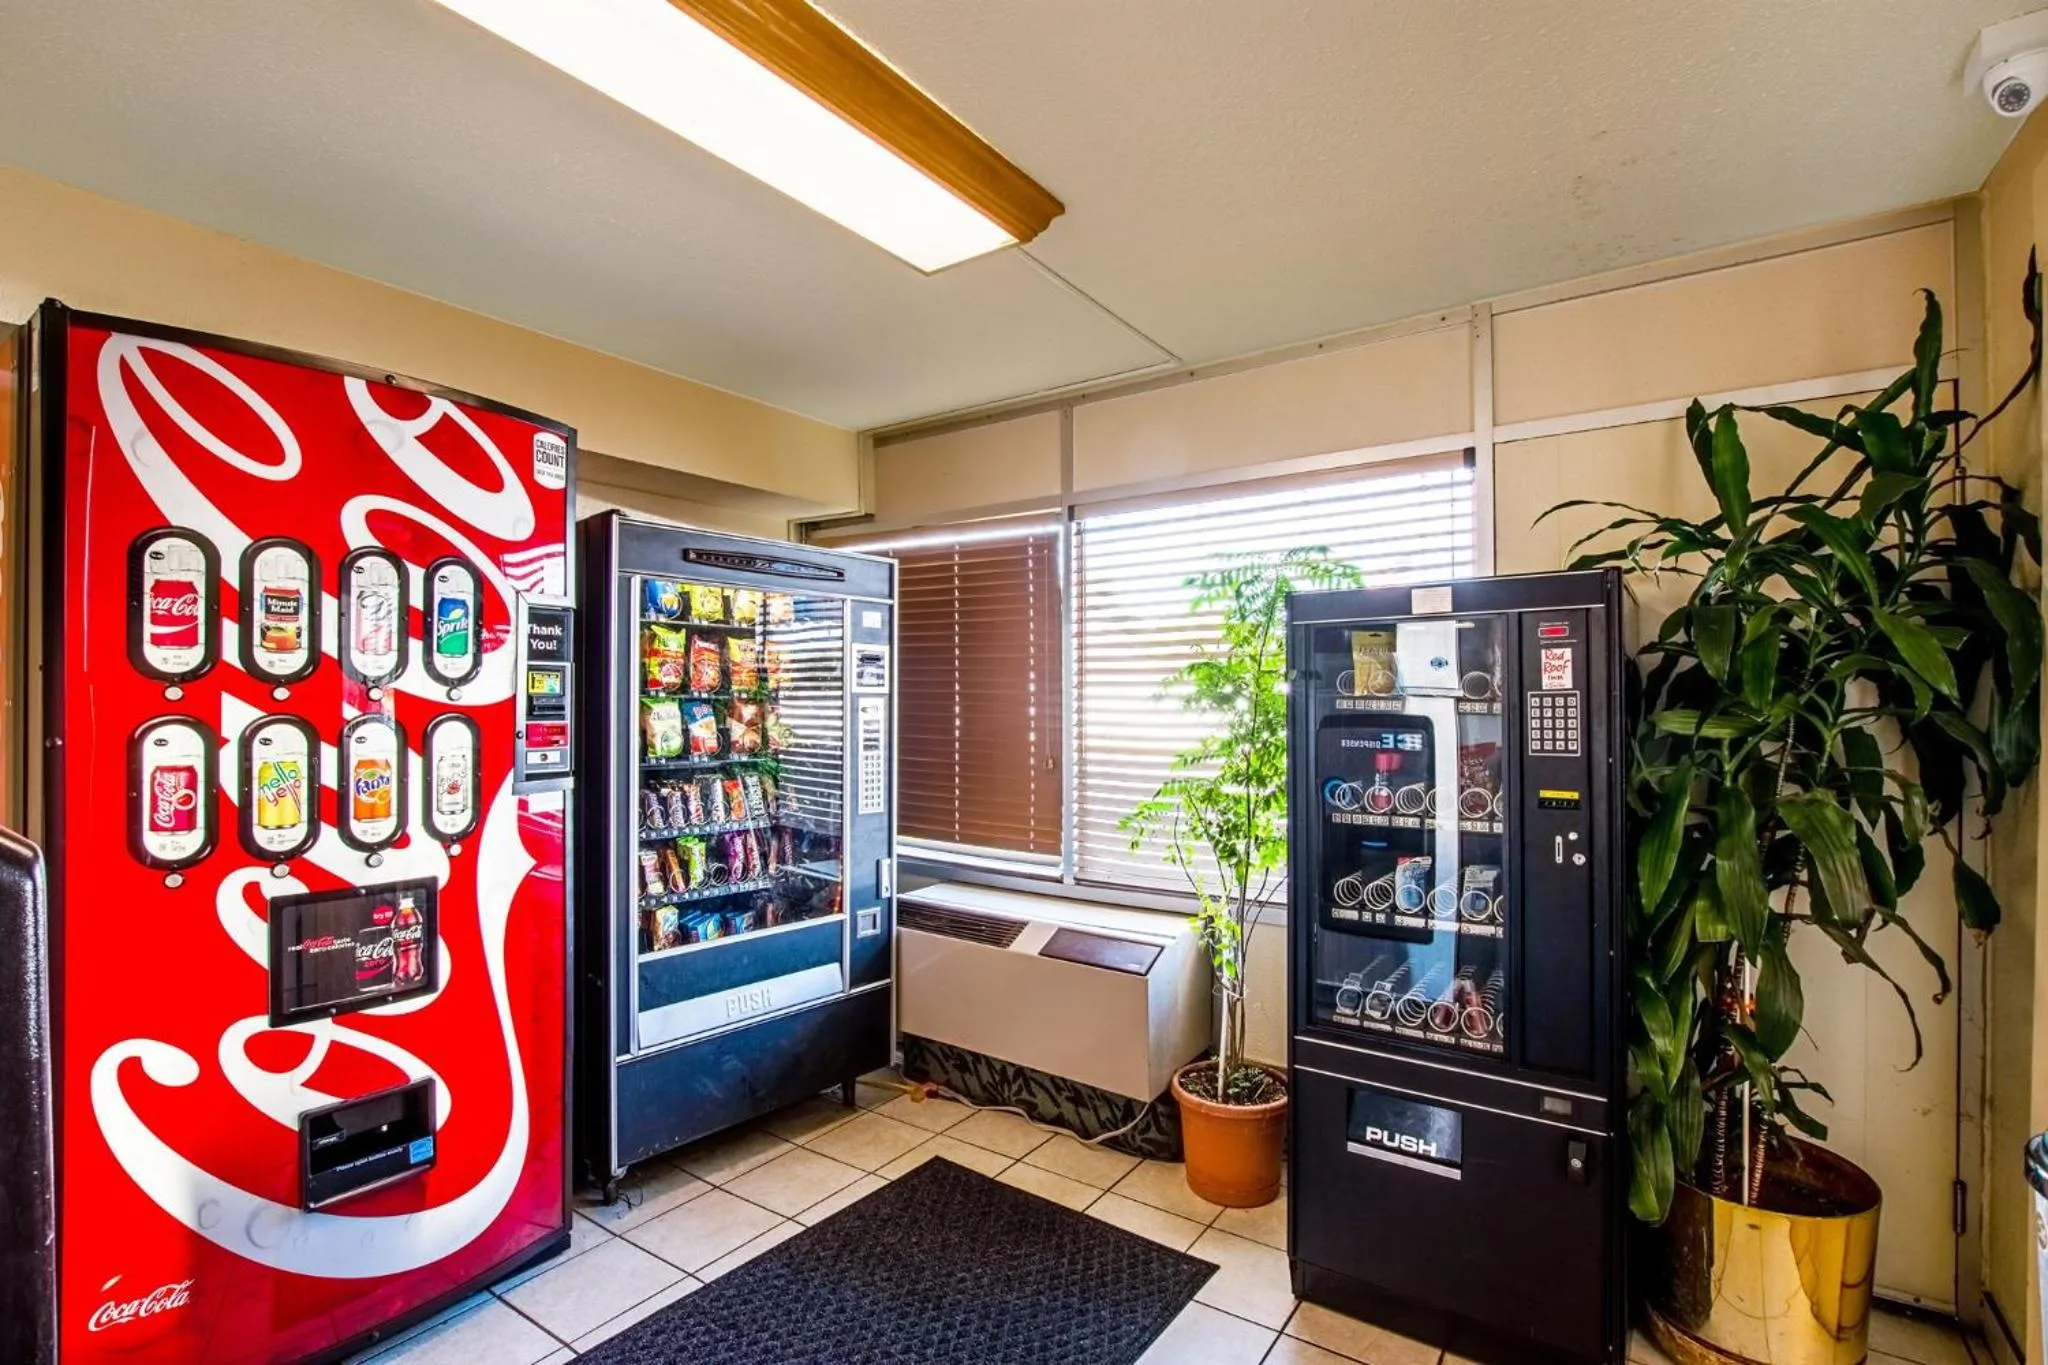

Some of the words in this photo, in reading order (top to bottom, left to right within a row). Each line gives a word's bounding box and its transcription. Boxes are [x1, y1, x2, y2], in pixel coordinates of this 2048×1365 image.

[535, 439, 565, 455] CALORIES
[536, 450, 564, 468] COUNT
[267, 597, 298, 606] Minute
[271, 605, 295, 613] Maid
[528, 623, 562, 636] Thank
[530, 638, 557, 651] You!
[1545, 648, 1565, 660] Red
[1543, 659, 1571, 675] Roof
[258, 761, 297, 794] mello
[265, 779, 302, 814] yello
[726, 987, 773, 1018] PUSH
[1366, 1125, 1438, 1158] PUSH
[88, 1279, 195, 1331] Coca-Cola
